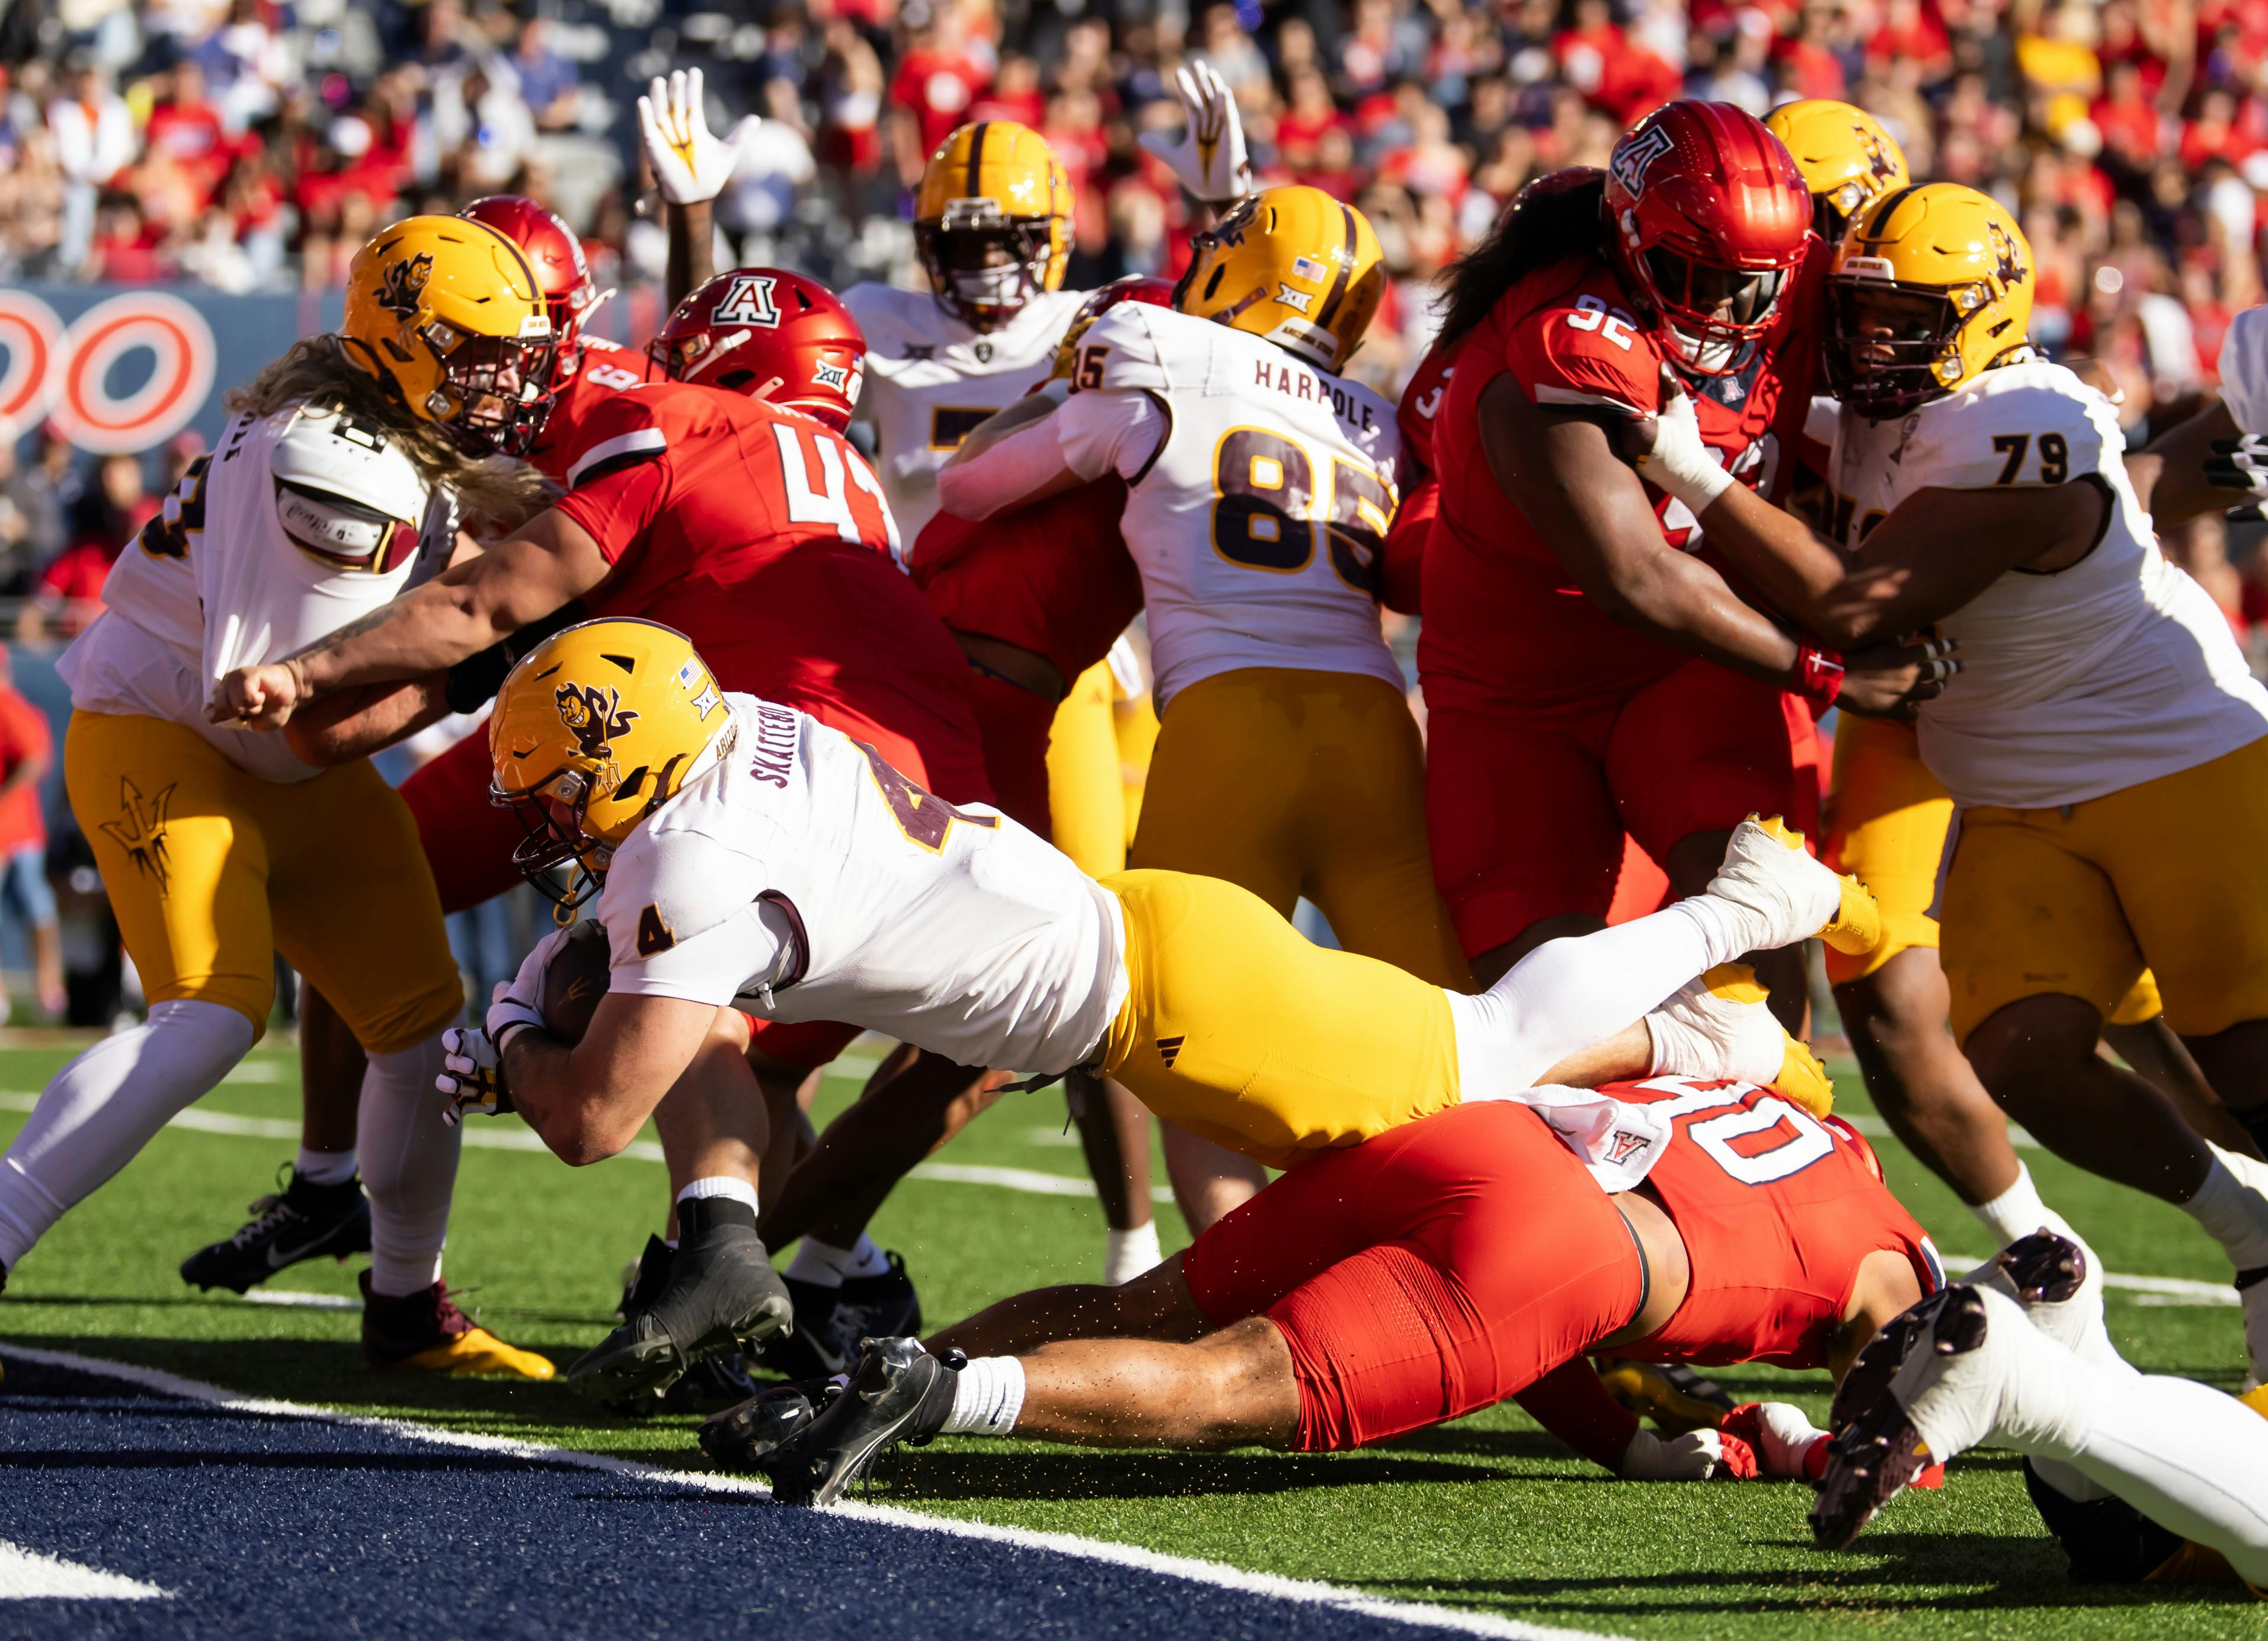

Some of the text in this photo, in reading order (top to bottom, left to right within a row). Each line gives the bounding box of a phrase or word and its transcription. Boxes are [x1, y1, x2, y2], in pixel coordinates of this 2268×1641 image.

[1611, 124, 1674, 200] A
[711, 276, 781, 328] A
[1567, 293, 1637, 351] 92
[812, 359, 848, 393] XII
[1255, 360, 1373, 433] HARPOLE
[1992, 432, 2068, 485] 79
[770, 423, 910, 575] 47
[1210, 424, 1399, 596] 85
[750, 705, 795, 789] SKATTEBO
[844, 735, 1002, 858] 4
[635, 901, 677, 959] 4
